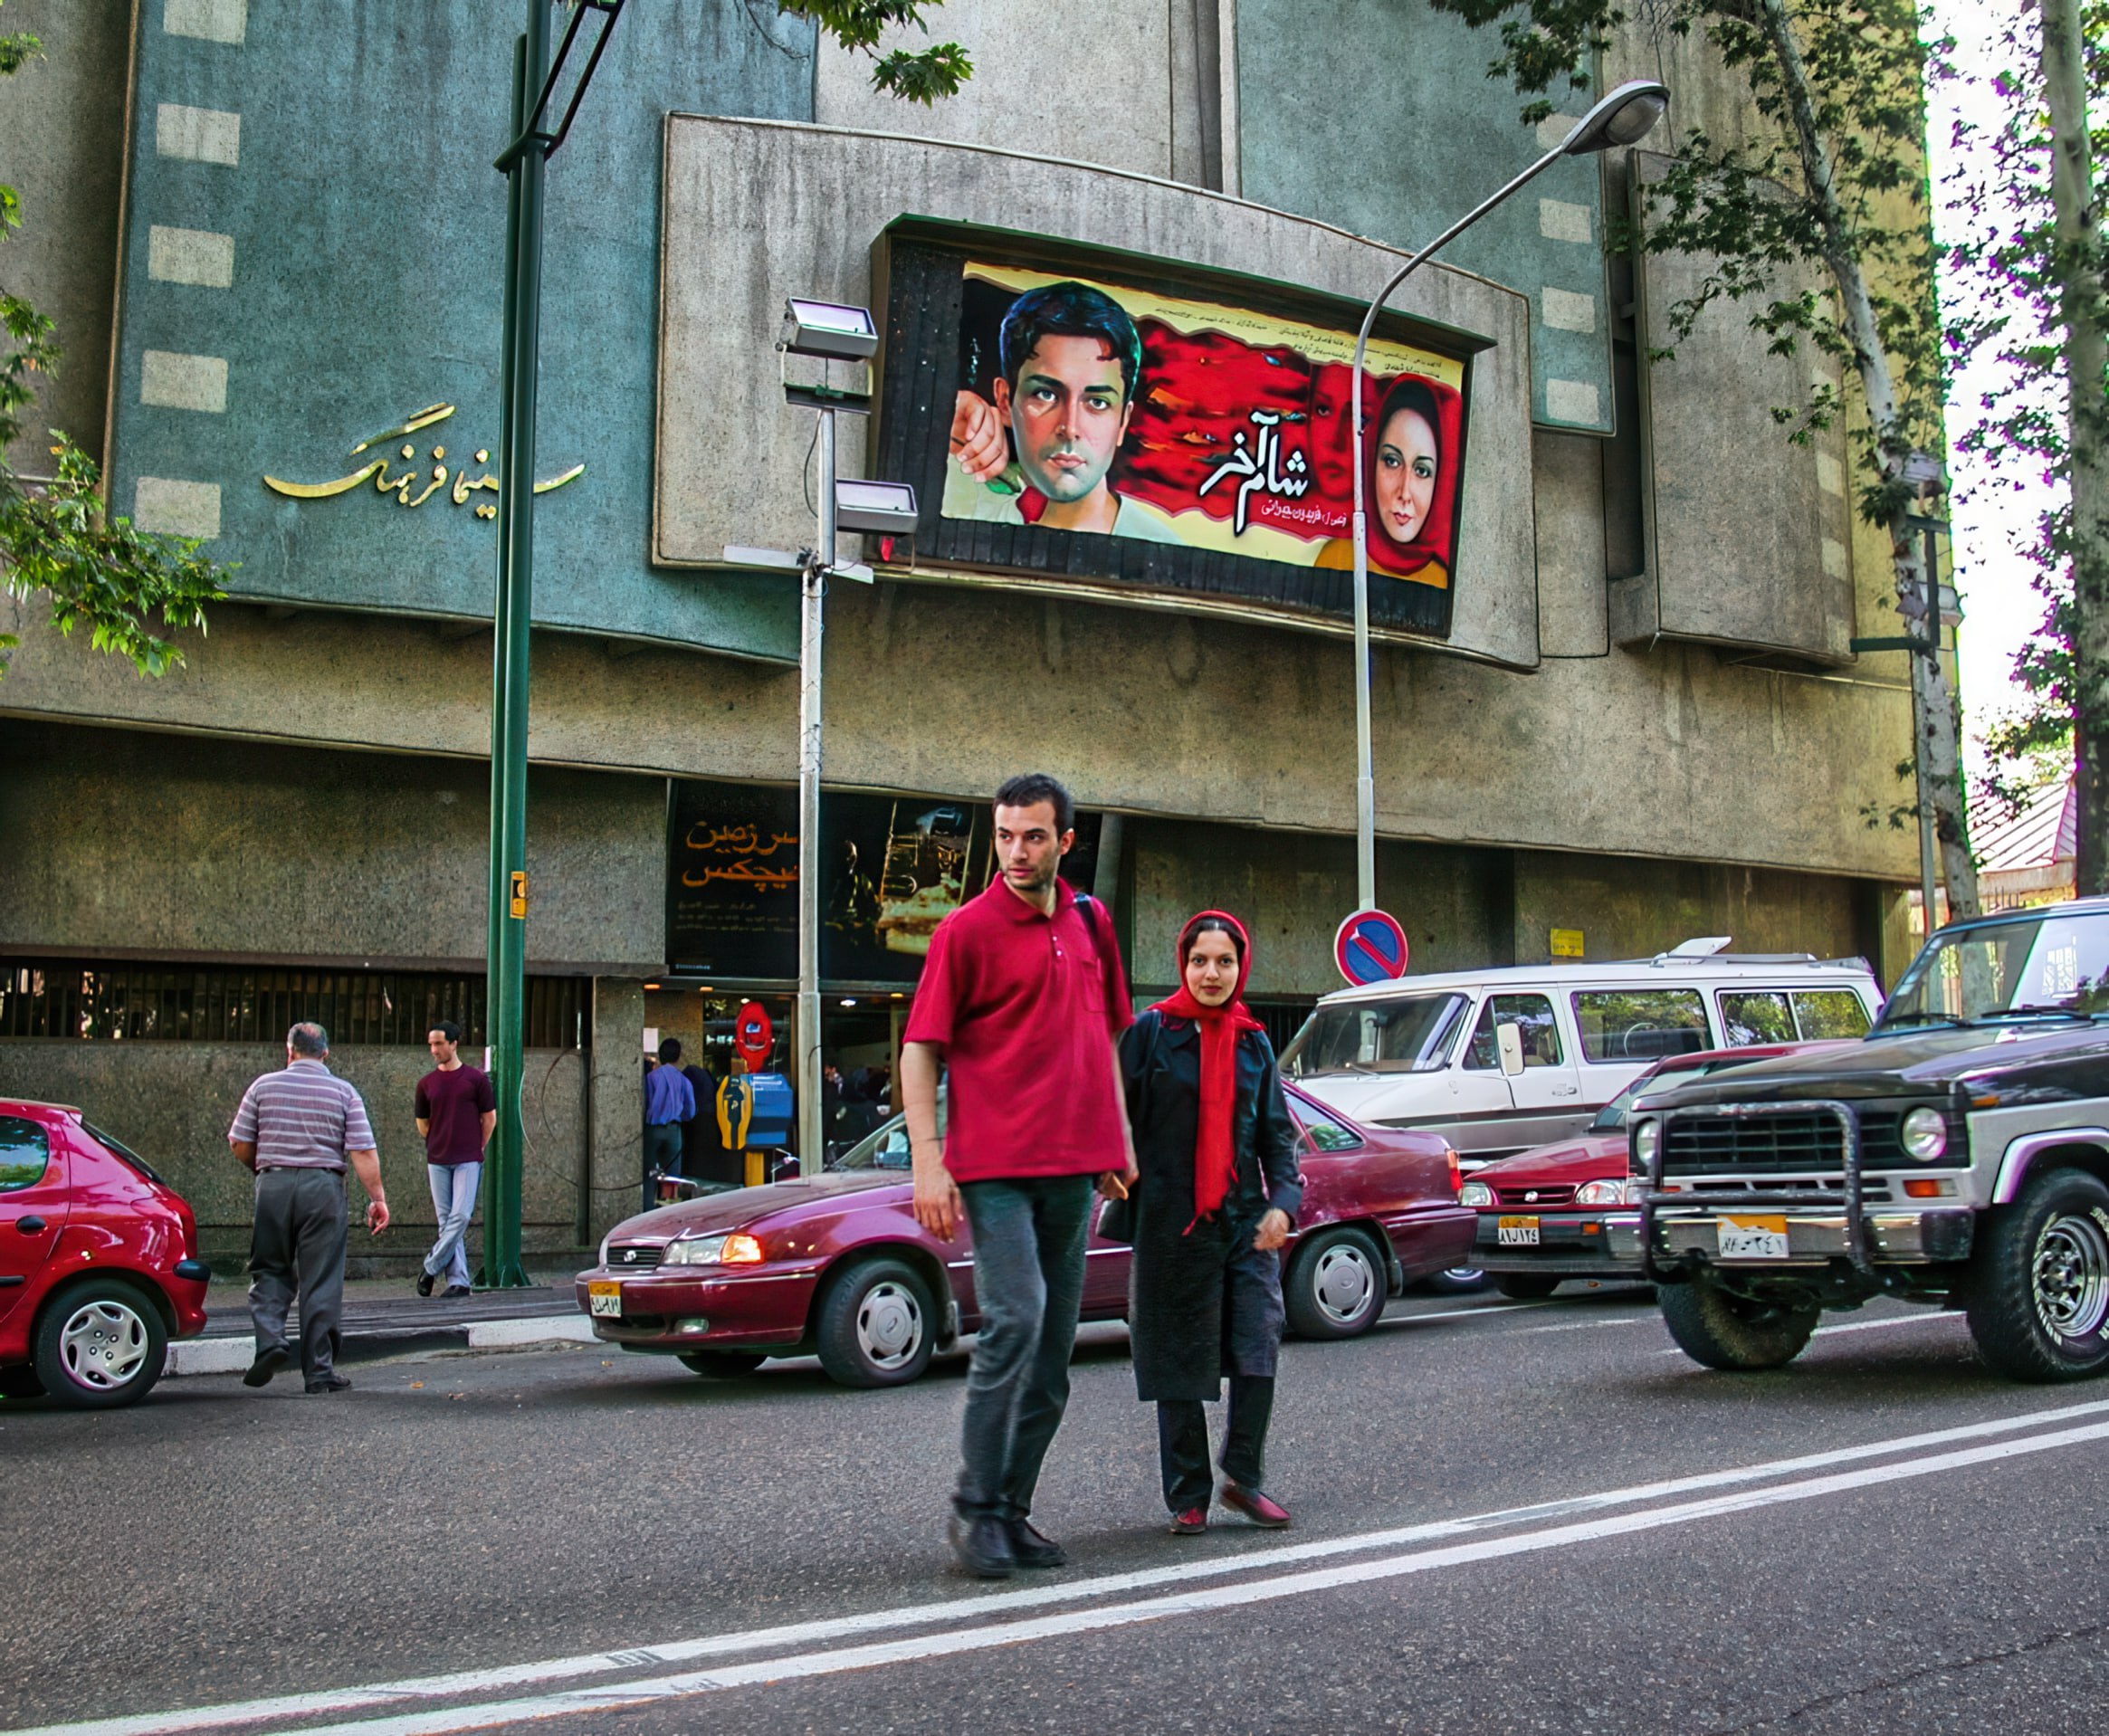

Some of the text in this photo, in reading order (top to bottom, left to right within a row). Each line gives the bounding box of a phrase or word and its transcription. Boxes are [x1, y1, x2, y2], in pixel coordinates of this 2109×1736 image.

[262, 401, 455, 507] فرهنگ
[1199, 410, 1309, 534] شام آخر
[1292, 504, 1322, 524] فریدون
[682, 858, 800, 893] یچکس
